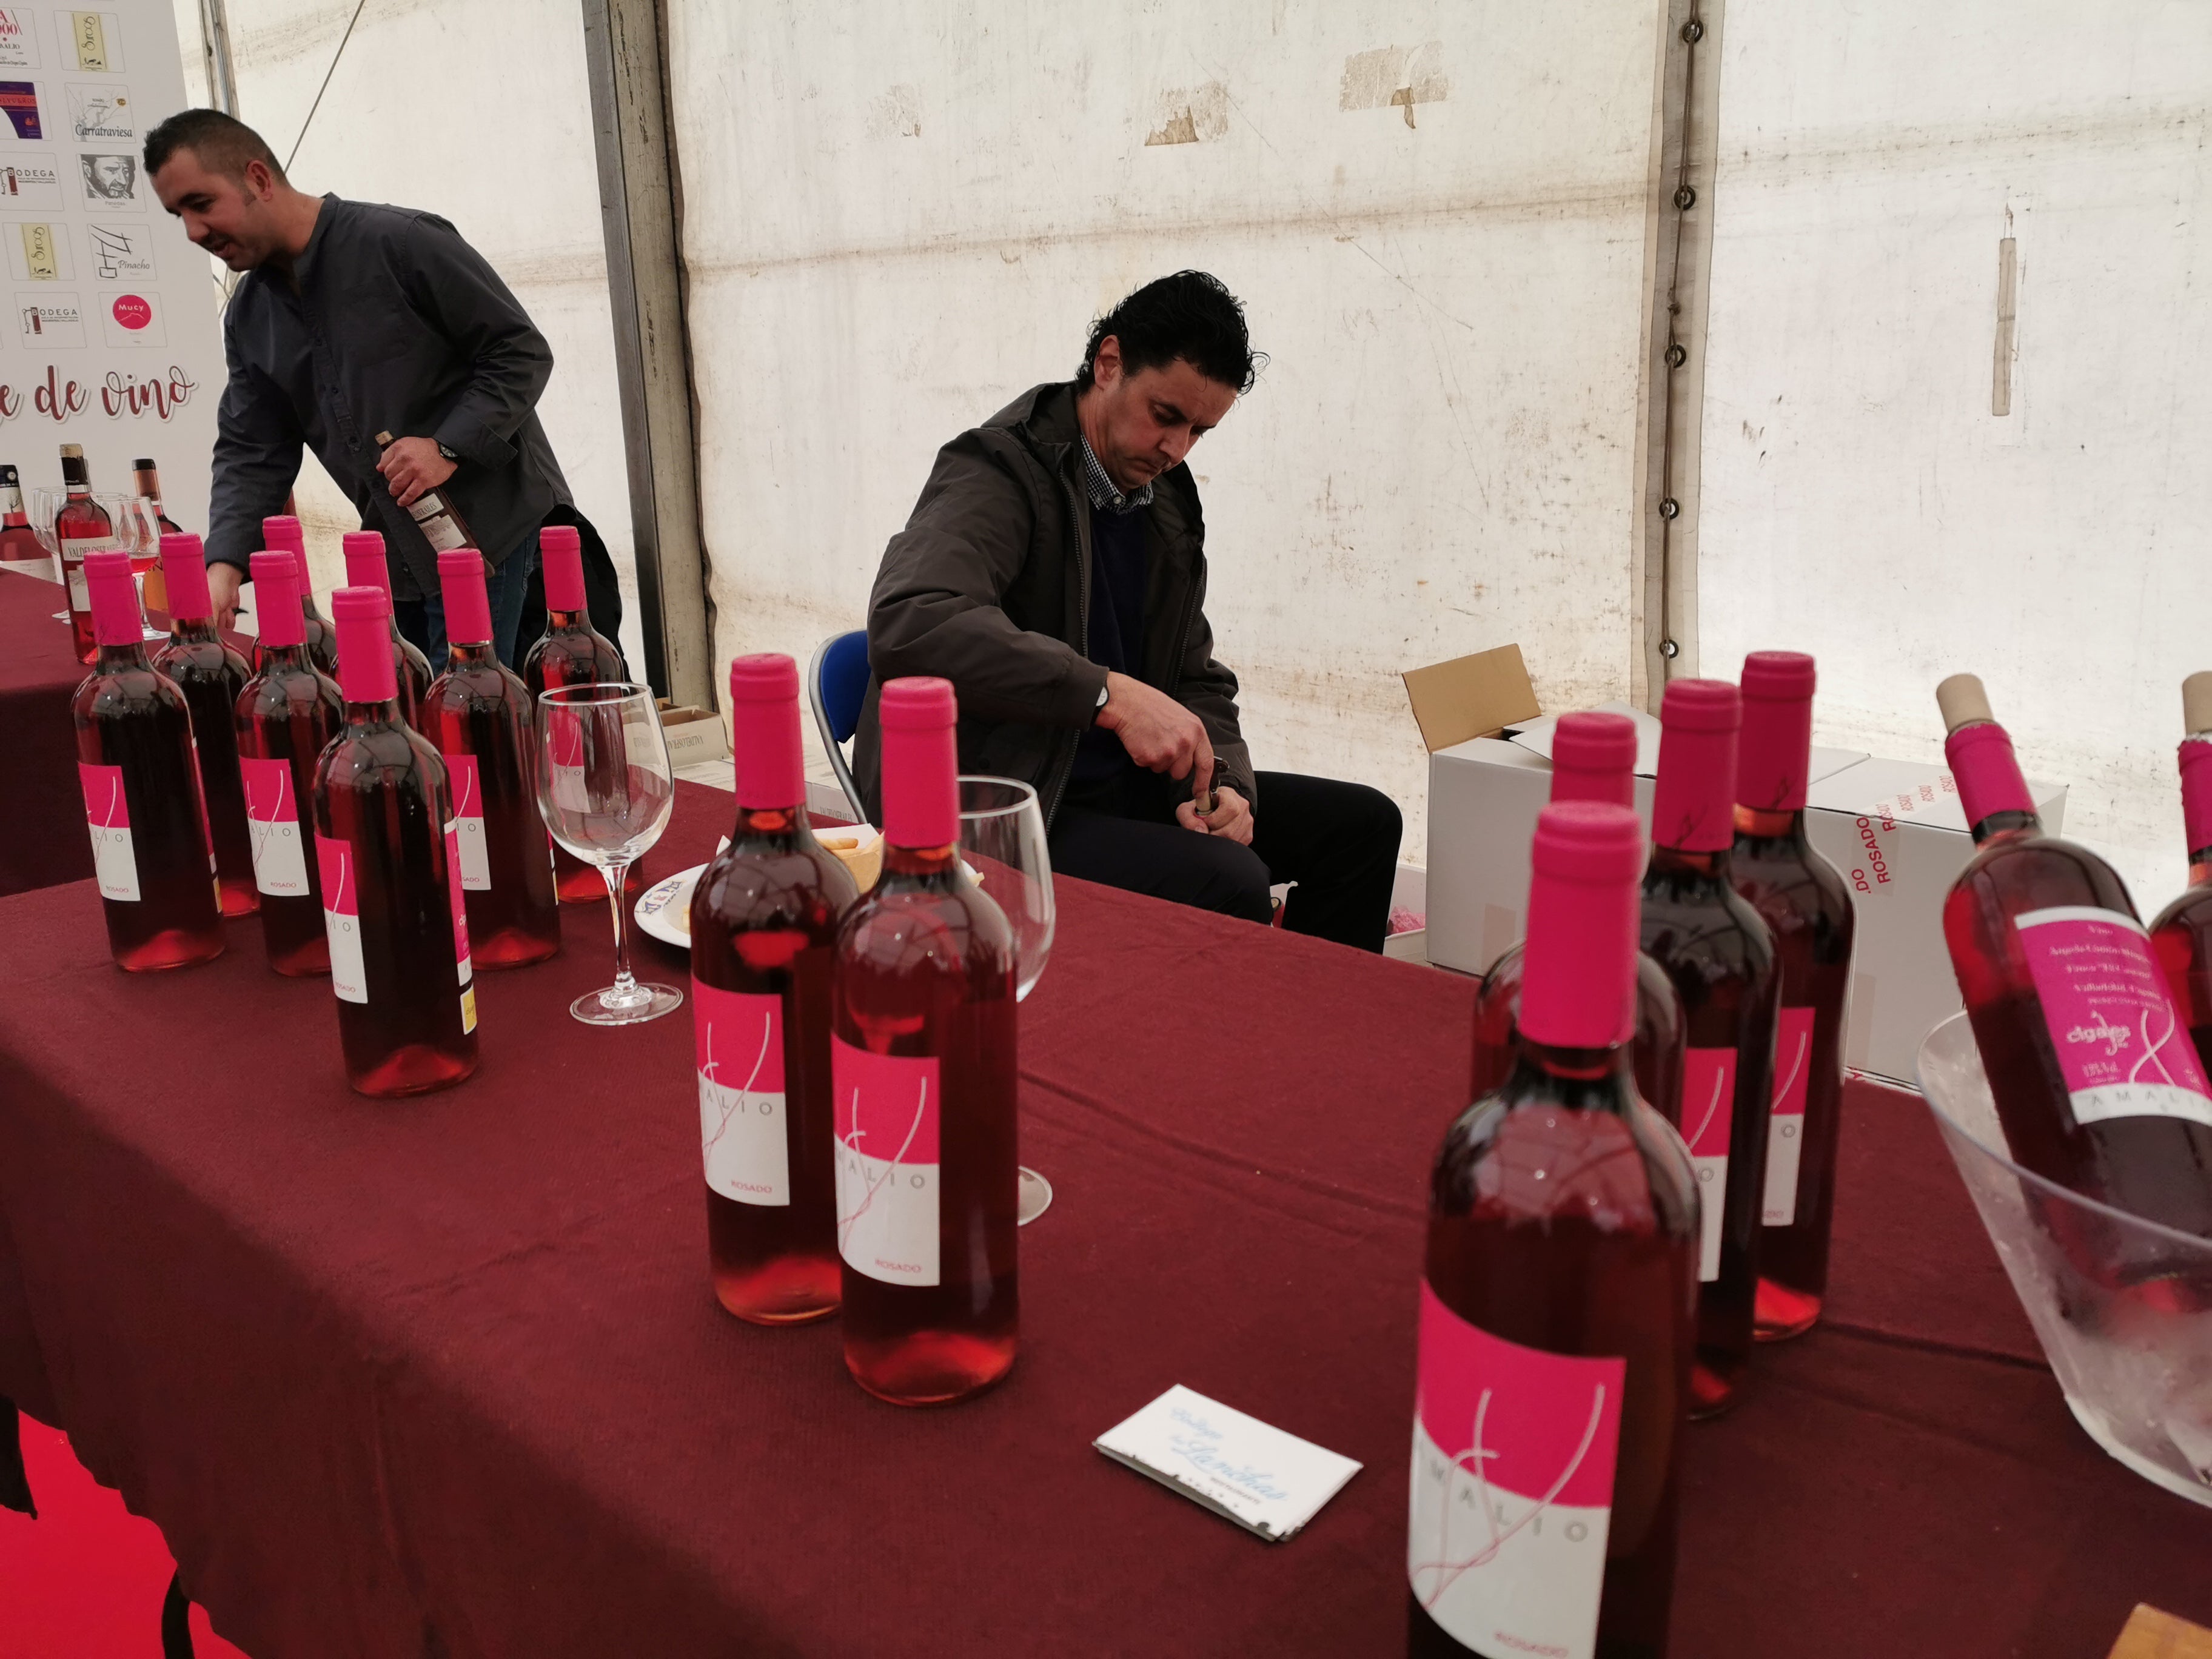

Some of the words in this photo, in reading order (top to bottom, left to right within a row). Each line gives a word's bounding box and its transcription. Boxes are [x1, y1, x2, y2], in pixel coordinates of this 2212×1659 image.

[0, 23, 18, 35] 00
[75, 124, 133, 138] Carratraviesa
[8, 169, 55, 177] BODEGA
[118, 258, 150, 270] Pinacho
[35, 365, 86, 420] de
[101, 366, 195, 419] vino
[1856, 817, 1891, 884] ROSADO
[731, 1180, 773, 1194] ROSADO
[874, 1258, 922, 1273] ROSADO
